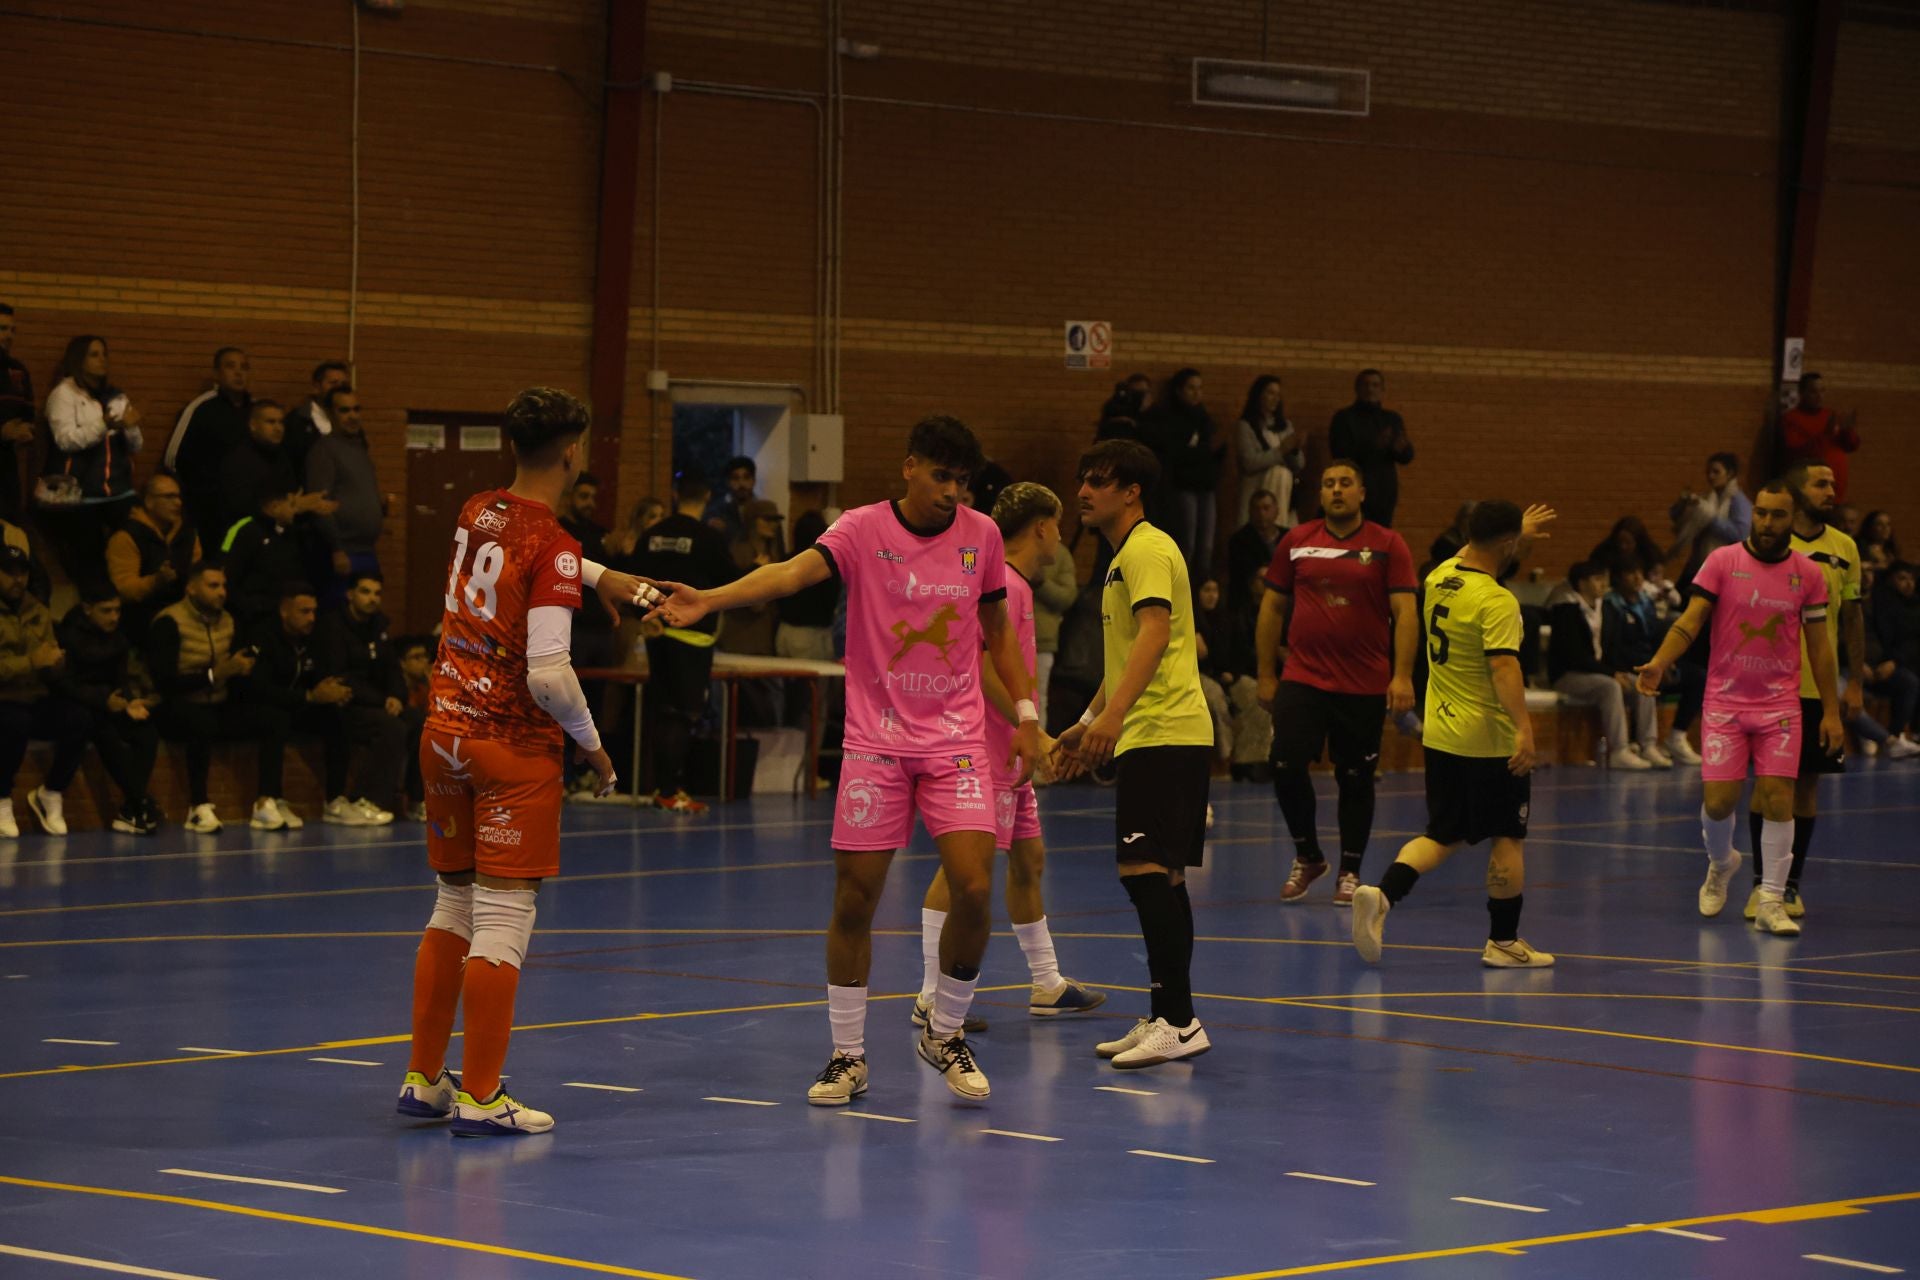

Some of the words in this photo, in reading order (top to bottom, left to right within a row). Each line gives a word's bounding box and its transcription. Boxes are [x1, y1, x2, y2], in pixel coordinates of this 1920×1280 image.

[445, 526, 504, 622] 18
[1430, 603, 1450, 665] 5
[1780, 733, 1791, 749] 7
[956, 776, 983, 799] 21
